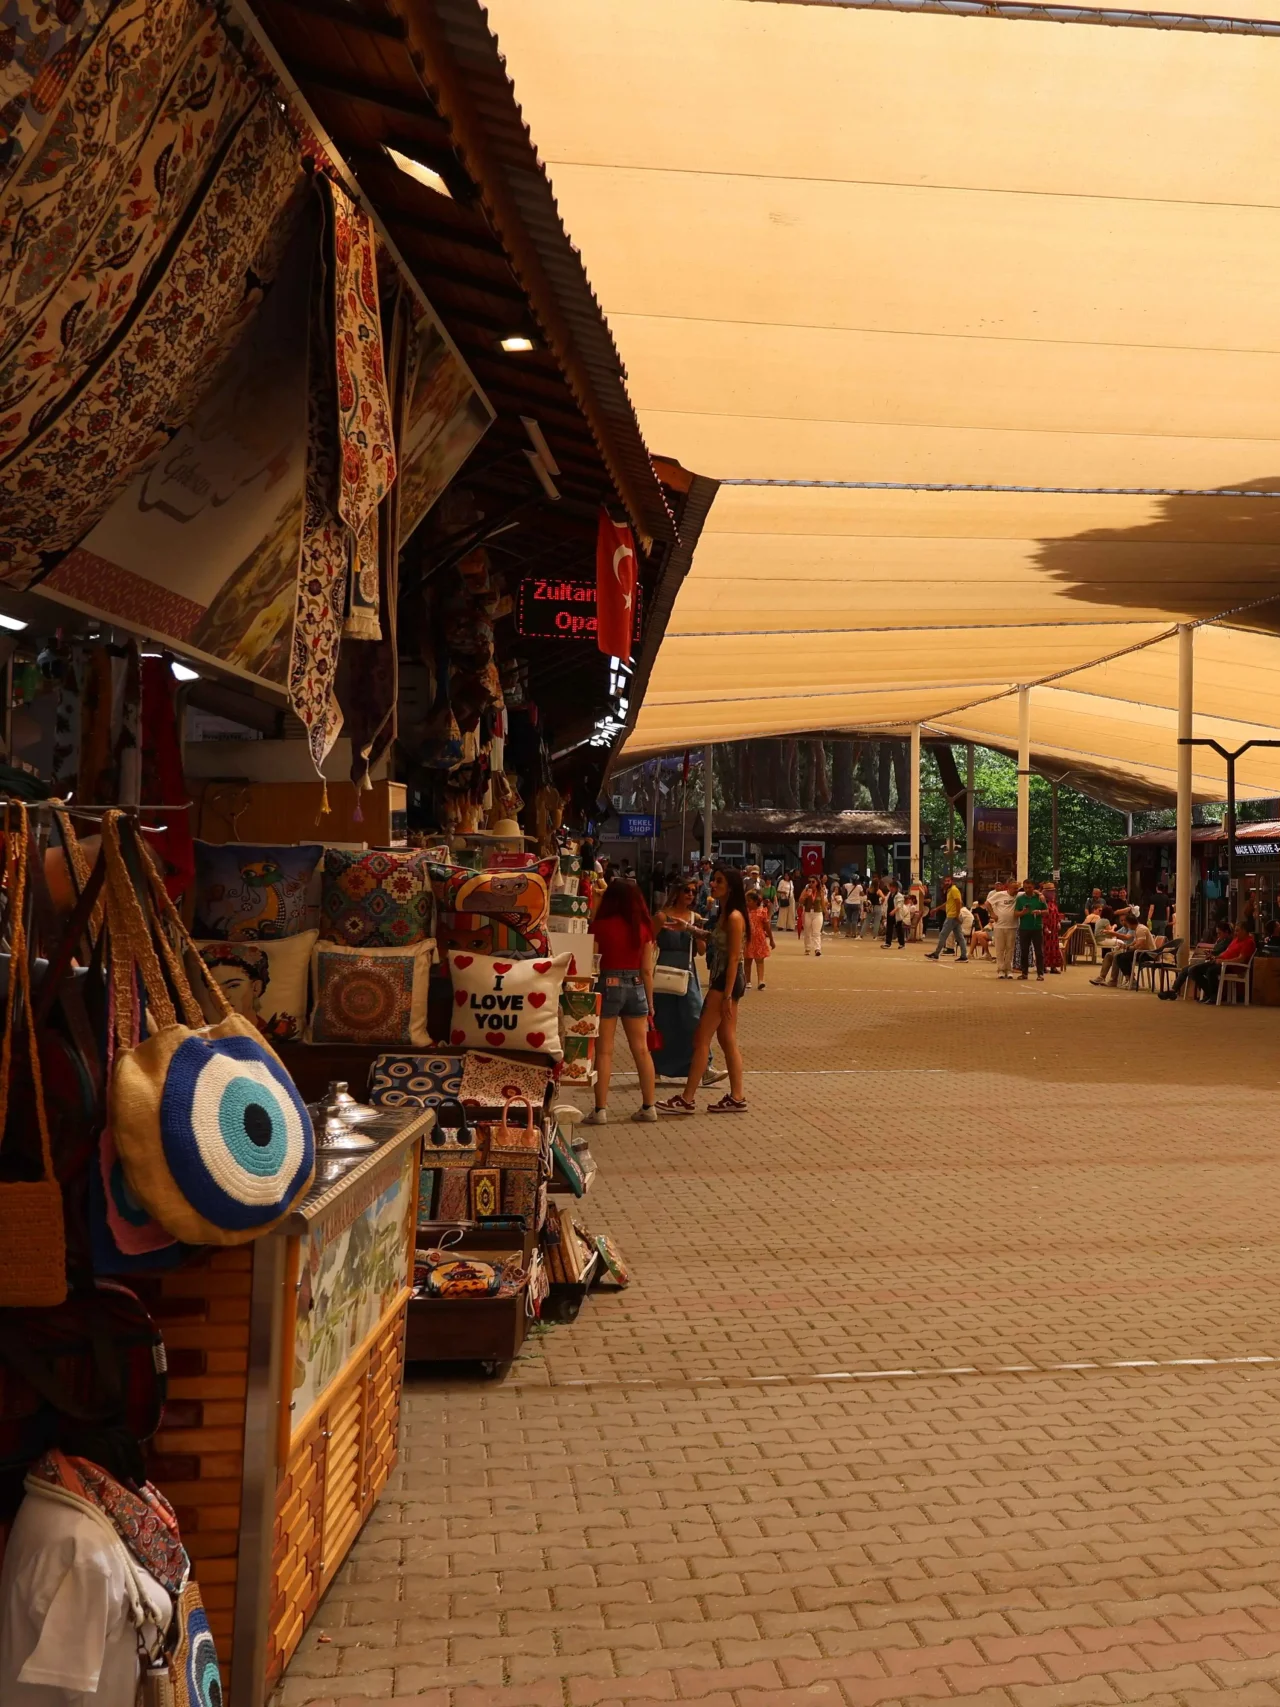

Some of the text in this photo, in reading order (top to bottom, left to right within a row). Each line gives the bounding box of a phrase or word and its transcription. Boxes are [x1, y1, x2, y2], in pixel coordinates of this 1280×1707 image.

[493, 975, 504, 991] I
[470, 993, 524, 1011] LOVE
[474, 1013, 518, 1031] YOU
